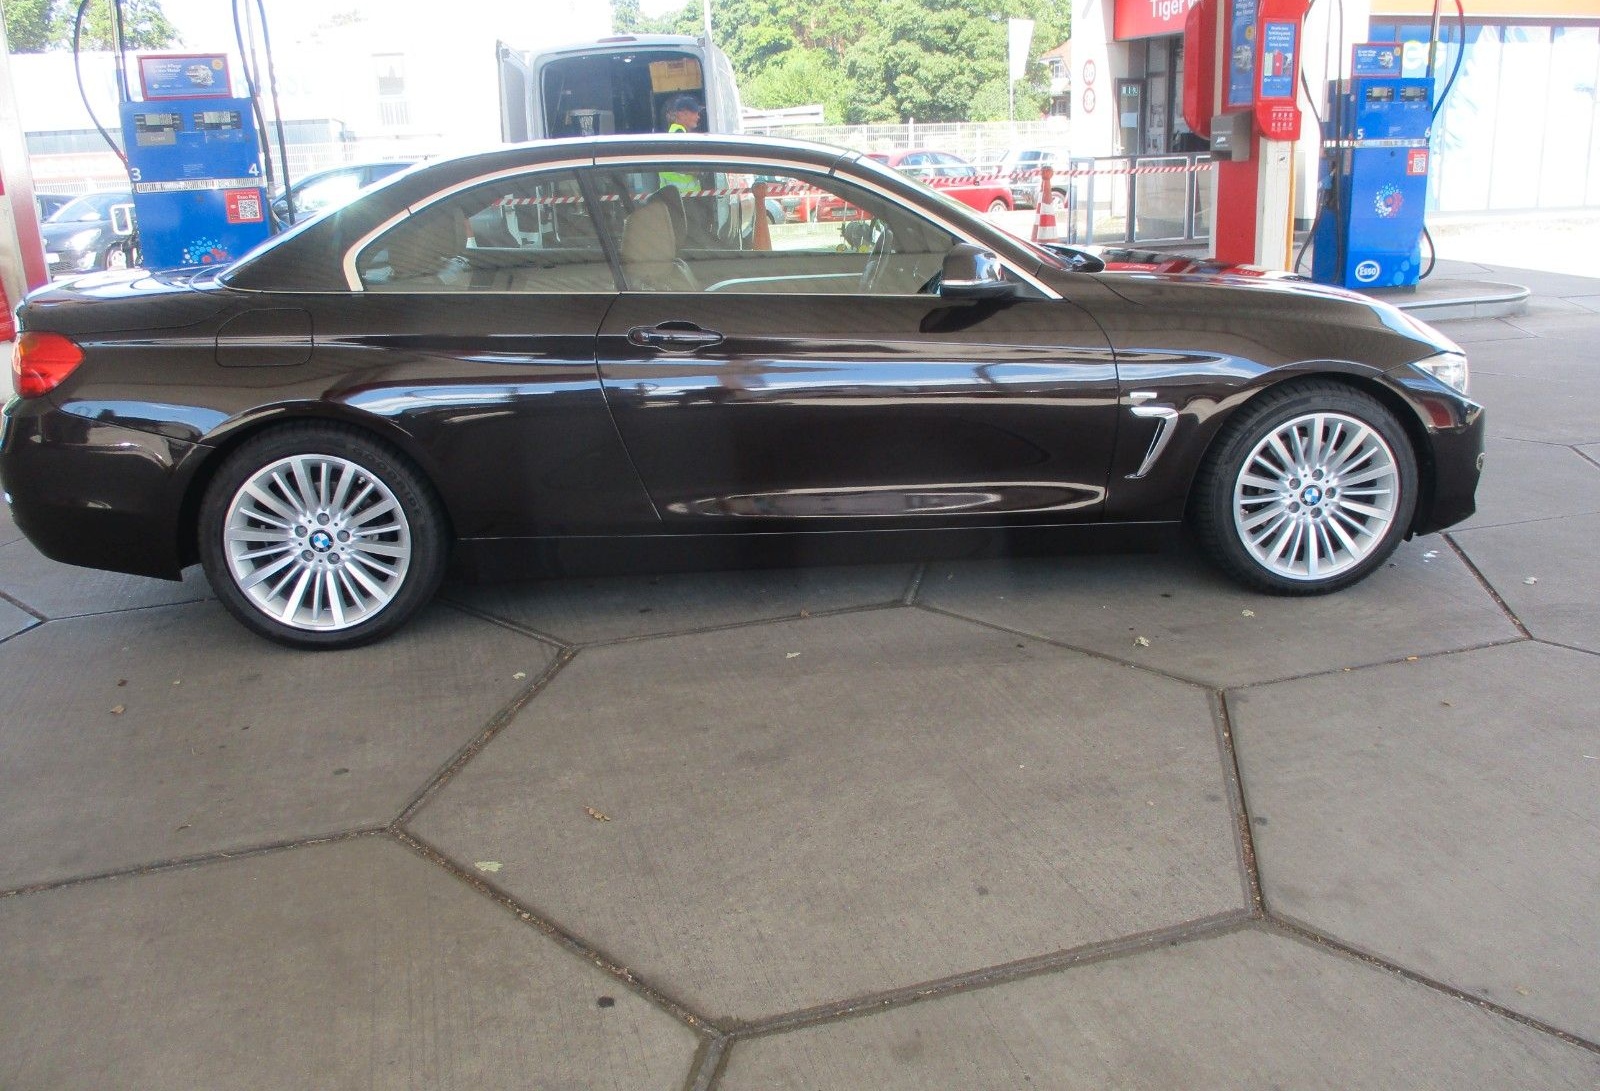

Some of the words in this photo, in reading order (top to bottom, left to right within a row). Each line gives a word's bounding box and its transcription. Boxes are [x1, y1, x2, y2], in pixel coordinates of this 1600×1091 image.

[1150, 0, 1184, 21] Tiger
[1357, 128, 1364, 139] 5
[1424, 127, 1431, 138] 6
[130, 168, 142, 181] 3
[248, 163, 260, 176] 4
